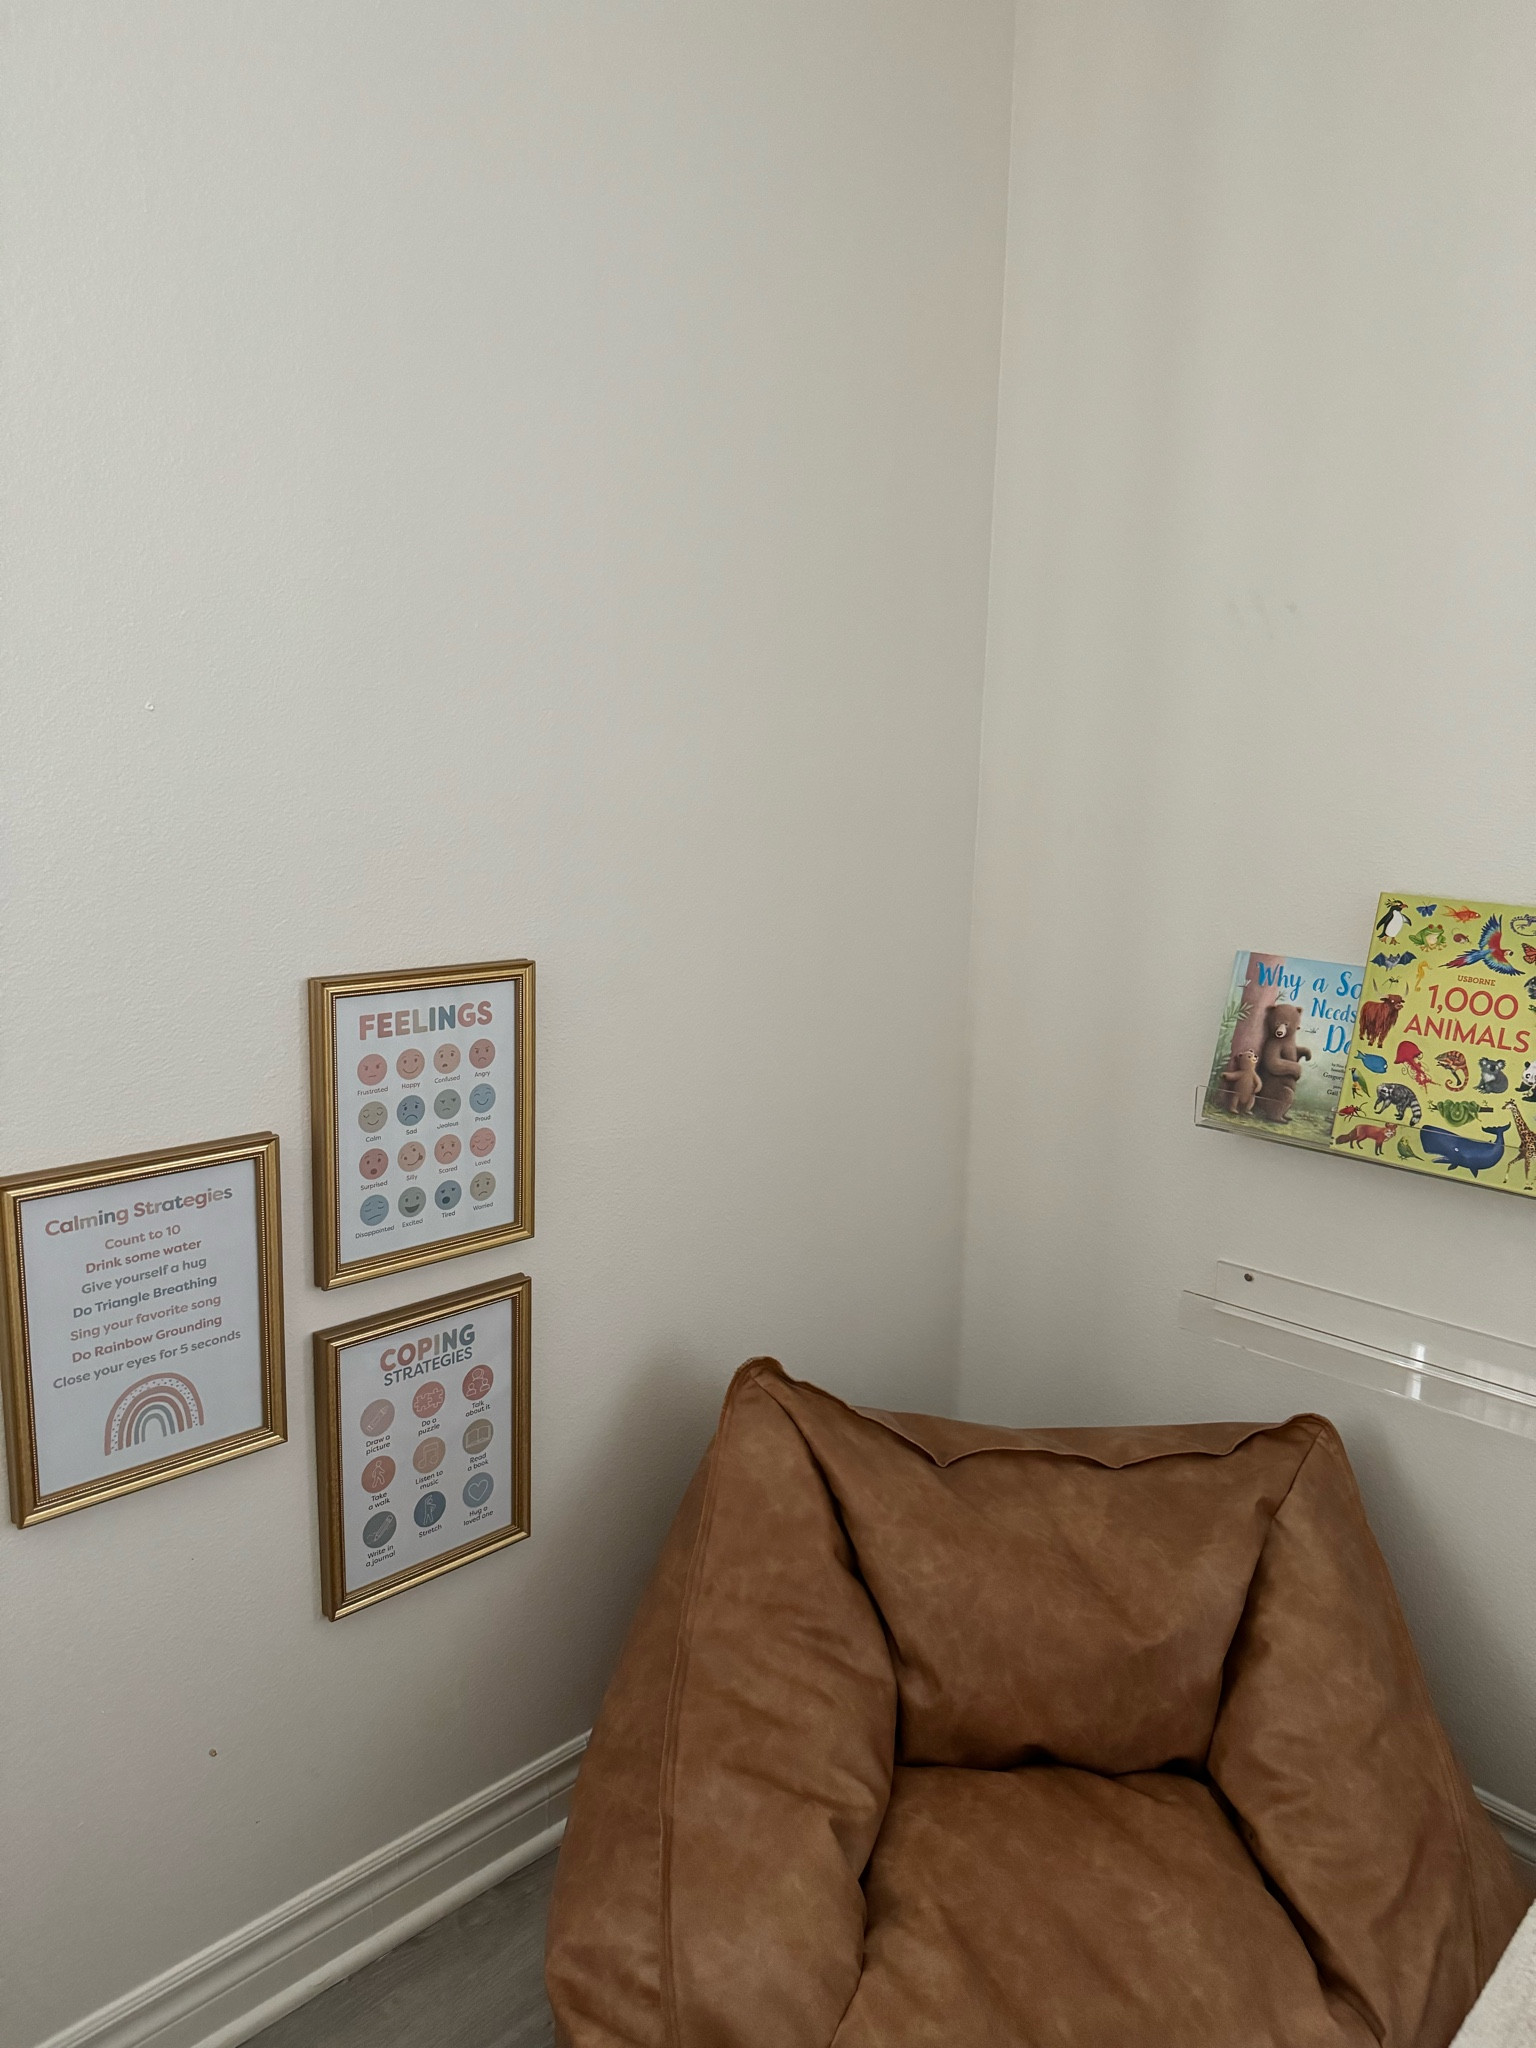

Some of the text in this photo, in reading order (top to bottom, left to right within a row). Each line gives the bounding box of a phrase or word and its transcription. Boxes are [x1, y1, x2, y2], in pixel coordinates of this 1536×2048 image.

[1256, 962, 1363, 1001] Why a So
[1457, 975, 1496, 986] USBORNE
[1428, 984, 1519, 1020] 1,000
[1311, 998, 1357, 1023] Needs
[359, 1001, 492, 1040] FEELINGS
[1404, 1014, 1530, 1053] ANIMALS
[434, 1075, 461, 1084] Confused
[357, 1086, 389, 1096] Frustrated
[436, 1121, 458, 1129] Jealous
[439, 1166, 458, 1174] Scared
[360, 1180, 388, 1191] Surprised
[45, 1187, 233, 1236] Calming Strategies
[473, 1202, 494, 1211] Worried
[402, 1219, 424, 1227] Excited
[105, 1224, 181, 1250] Count to 10
[355, 1225, 395, 1239] Disappointed
[86, 1239, 202, 1274] Drink some water
[81, 1257, 207, 1294] Give yourself a hug
[73, 1276, 217, 1318] Do Triangle Breathing
[70, 1295, 222, 1342] Sing your favorite song
[72, 1316, 222, 1363] Do Rainbow Grounding
[380, 1324, 475, 1371] COPING
[53, 1330, 241, 1389] Close your eyes for 5 seconds
[384, 1347, 473, 1386] STRATEGIES
[472, 1400, 484, 1409] Talk
[465, 1406, 484, 1417] about
[418, 1423, 440, 1436] puzzle
[366, 1438, 384, 1448] Draw
[366, 1442, 391, 1456] picture
[470, 1453, 487, 1464] Read
[473, 1460, 489, 1469] book
[415, 1474, 435, 1485] Listen
[420, 1479, 439, 1490] music
[372, 1492, 388, 1502] Take
[374, 1498, 390, 1507] walk
[464, 1510, 494, 1526] loved one
[469, 1509, 482, 1517] Hug
[419, 1524, 442, 1538] Stretch
[367, 1547, 386, 1559] Write
[371, 1551, 396, 1566] journal
